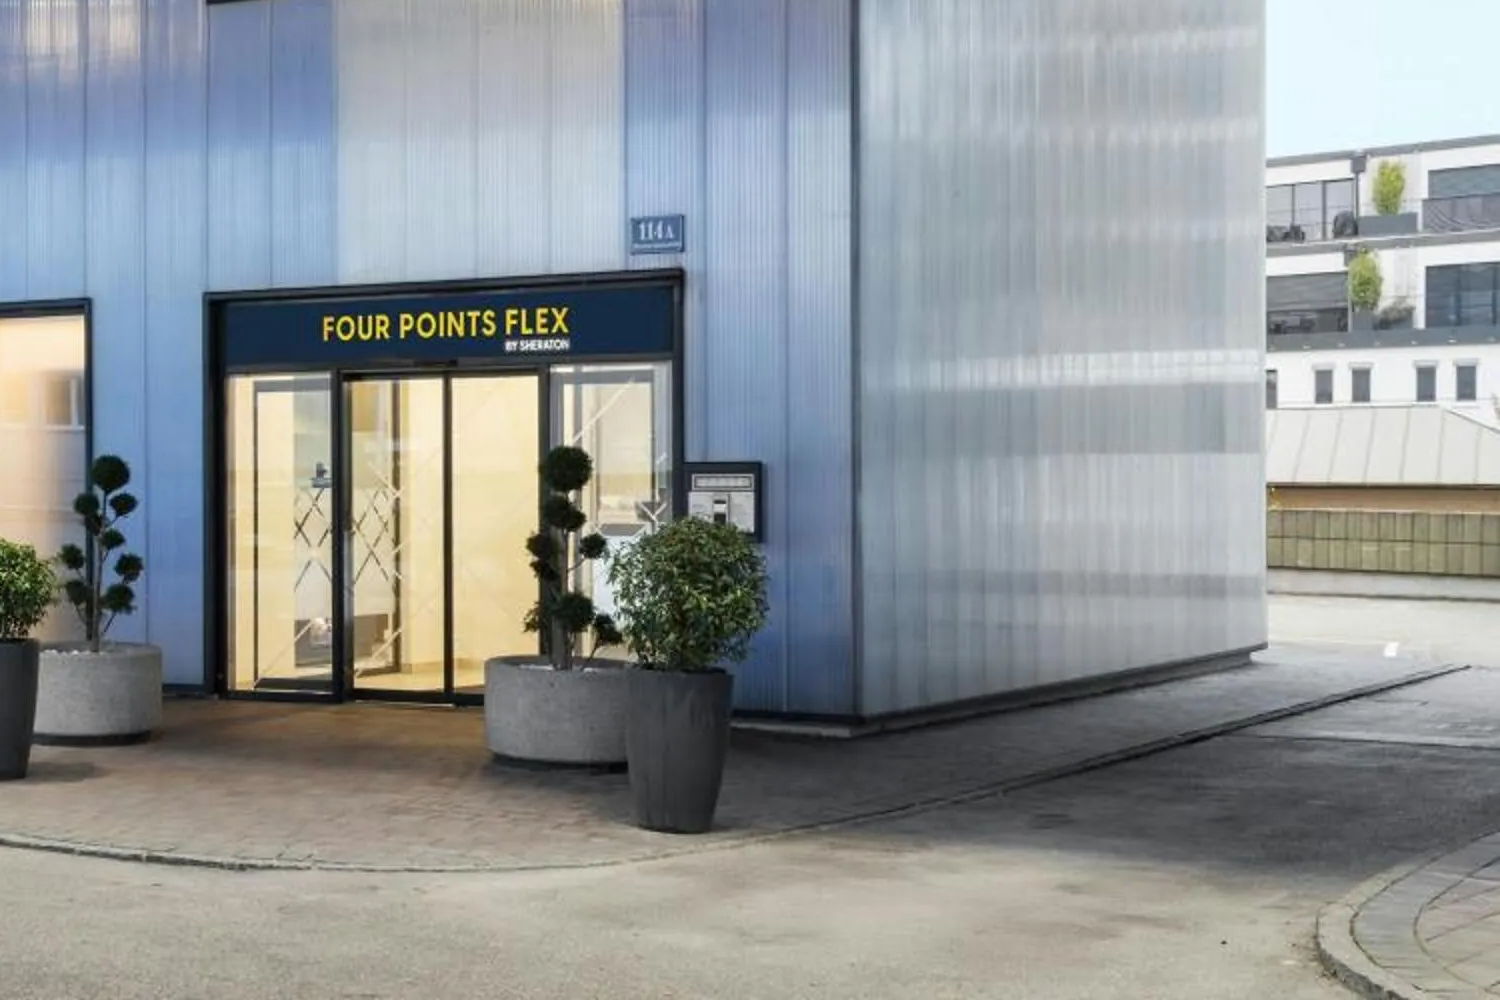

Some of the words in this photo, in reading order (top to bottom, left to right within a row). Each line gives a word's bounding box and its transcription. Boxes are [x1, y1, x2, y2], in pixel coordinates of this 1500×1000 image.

[322, 314, 390, 341] FOUR
[399, 309, 496, 338] POINTS
[504, 307, 569, 335] FLEX
[504, 340, 518, 352] BY
[519, 338, 570, 351] SHERATON
